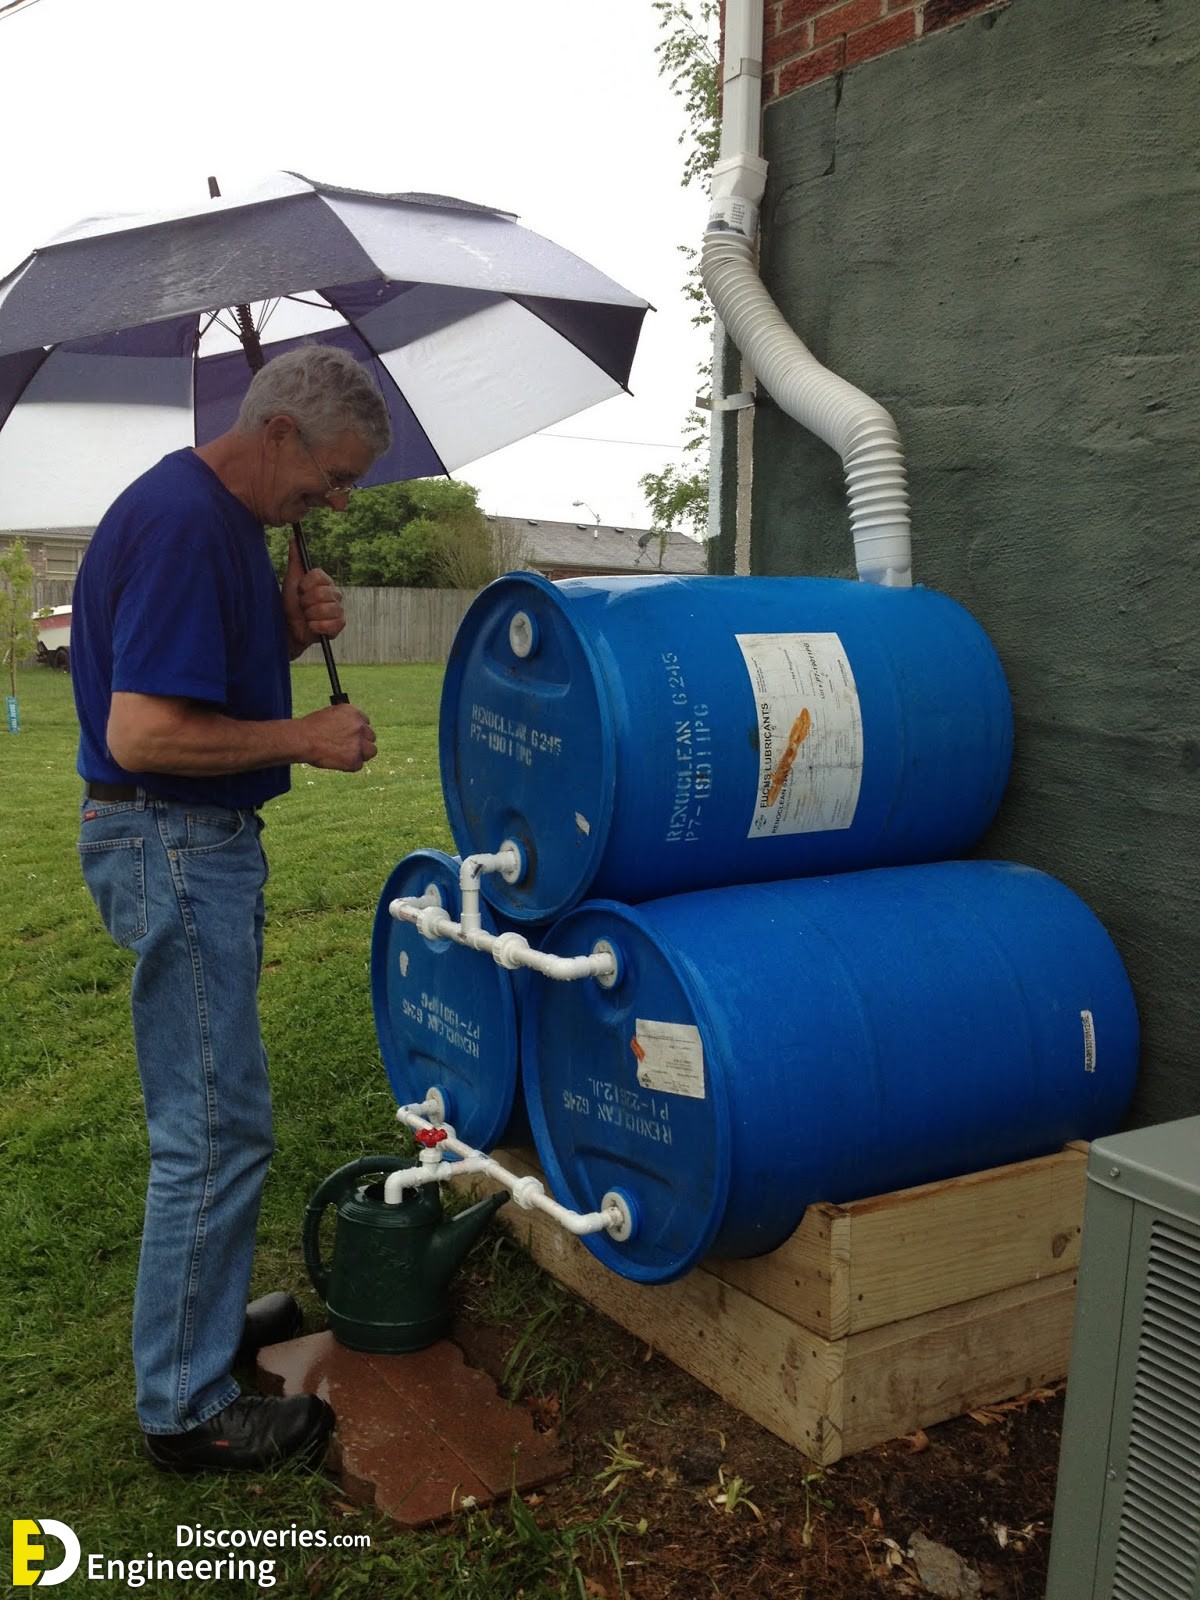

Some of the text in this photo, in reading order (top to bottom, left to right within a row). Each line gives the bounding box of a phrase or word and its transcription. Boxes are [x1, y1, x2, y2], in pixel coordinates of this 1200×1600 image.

[760, 702, 773, 770] LUBRICANTS
[665, 720, 693, 842] RENOCLEAN
[772, 789, 787, 834] RENOCLEAN
